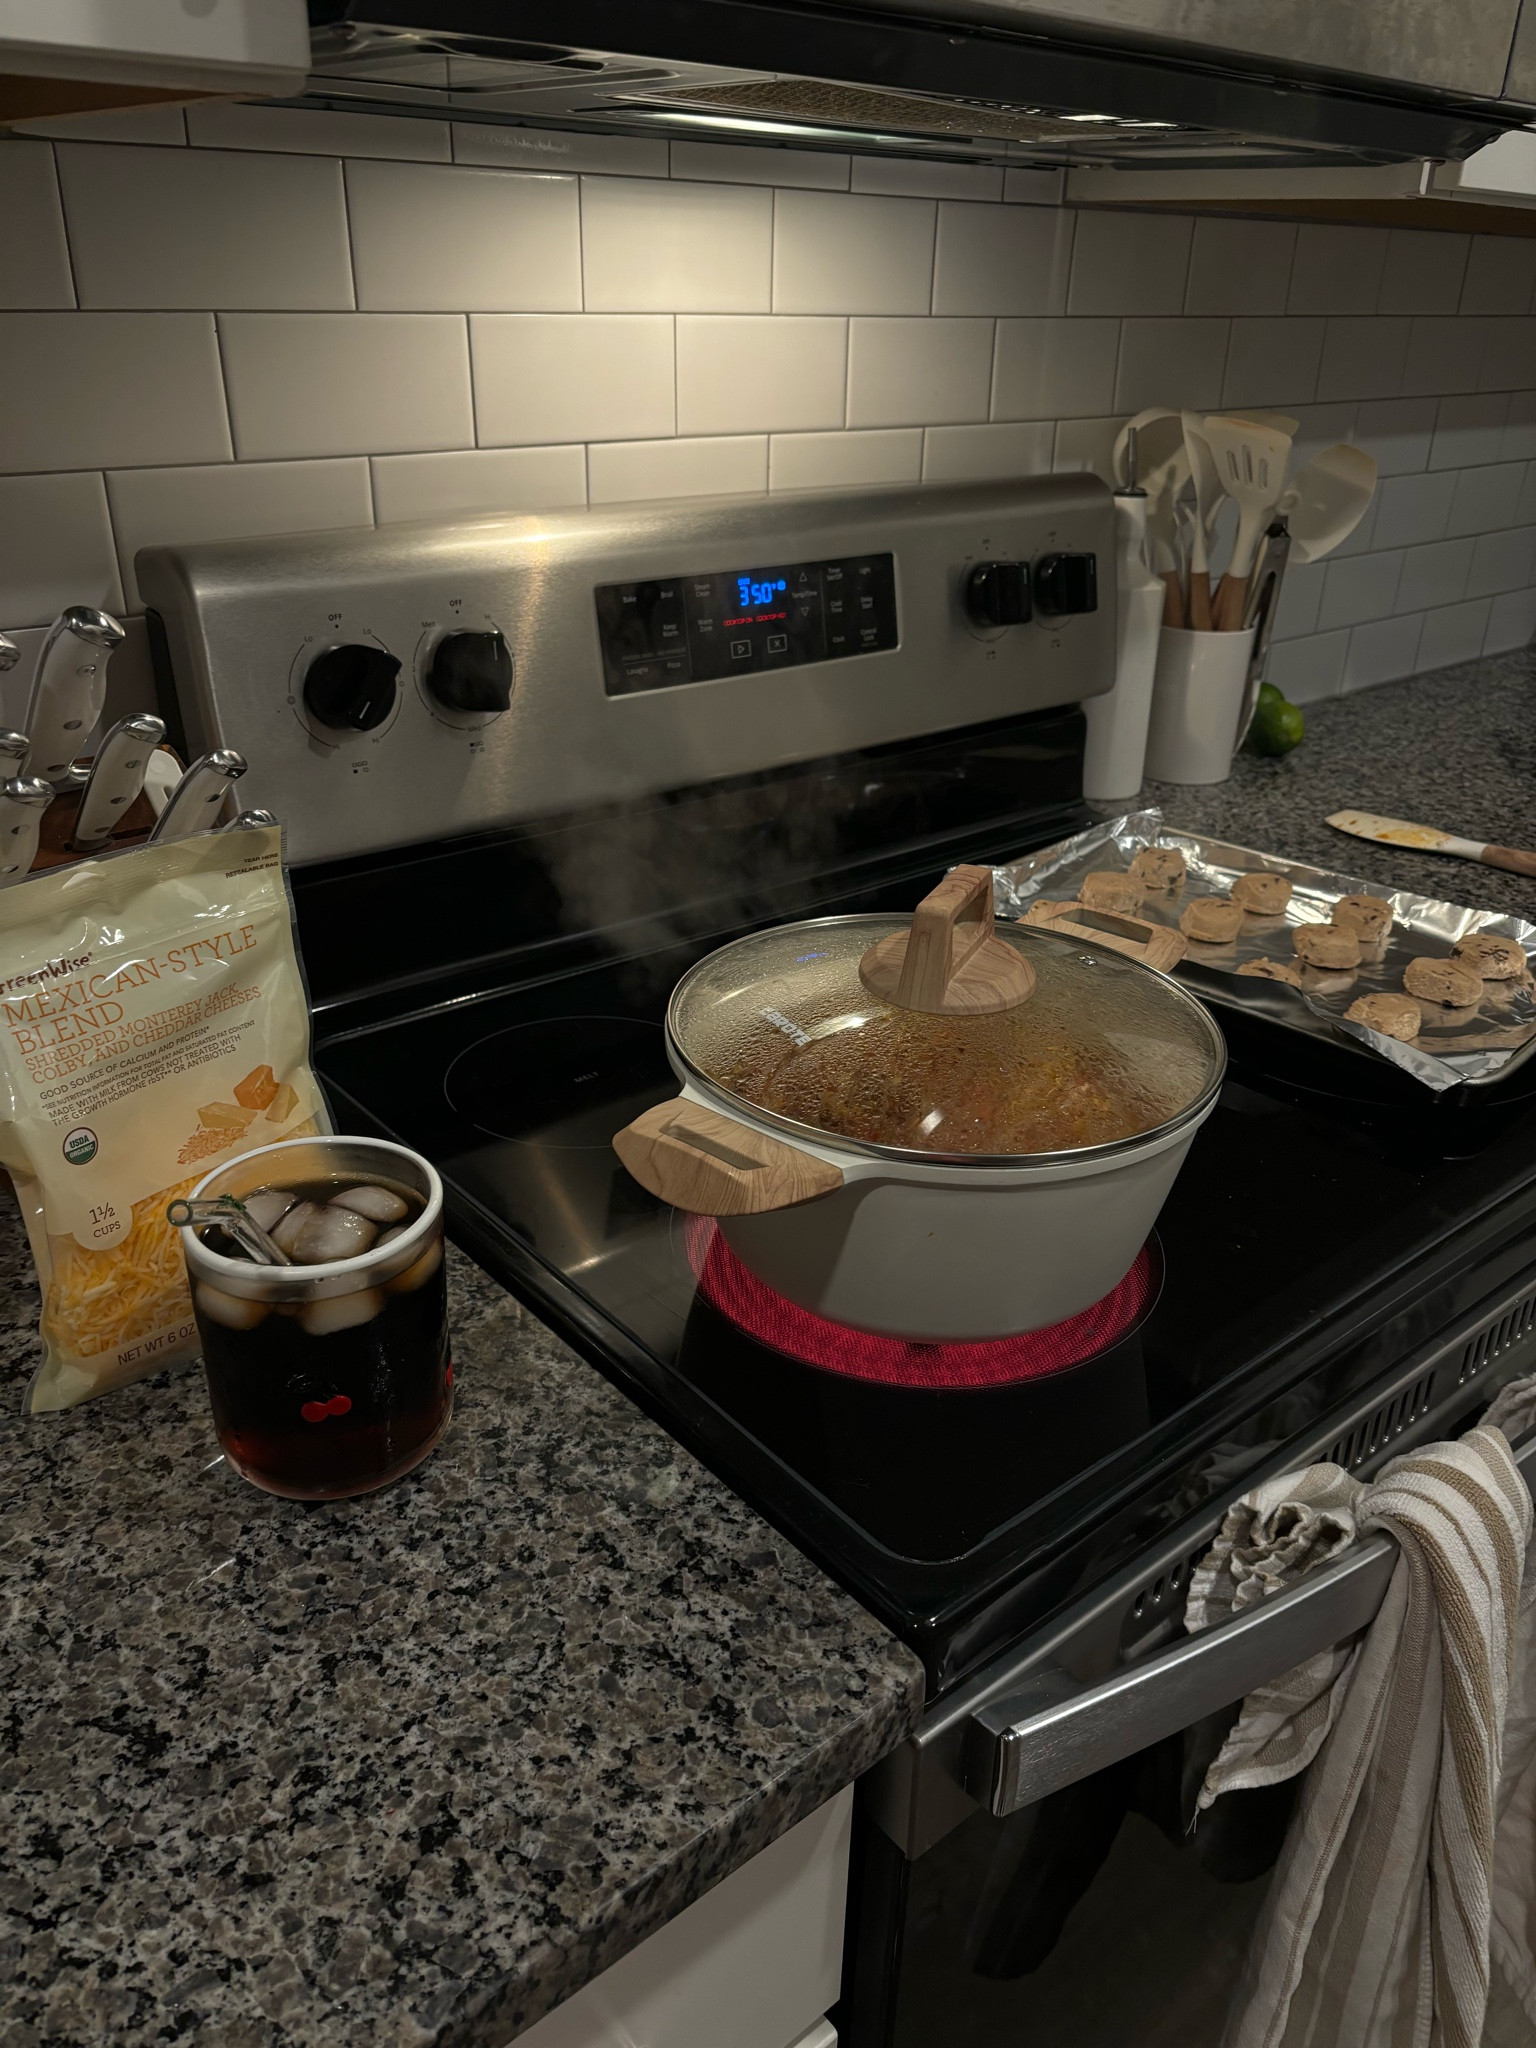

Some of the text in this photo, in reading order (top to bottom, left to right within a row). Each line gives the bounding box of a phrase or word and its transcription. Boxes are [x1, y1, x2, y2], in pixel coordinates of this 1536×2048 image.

[328, 613, 342, 621] OFF
[1, 924, 257, 1028] MEXICAN-STYLE
[11, 1001, 124, 1055] BLEND
[25, 982, 239, 1072] SHREDDED MONTEREY JACK
[32, 985, 261, 1084] COLBY, AND CHEDDAR CHEESES
[40, 1084, 69, 1100] GOOD
[70, 1068, 105, 1089] SOURCE
[105, 1063, 118, 1074] OF
[120, 1049, 157, 1069] CALCIUM
[158, 1041, 175, 1053] AND
[48, 1033, 242, 1119] MADE WITH MILK FROM COWS NOT TREATED WITH
[51, 1114, 71, 1127] THE
[71, 1099, 108, 1120] GROWTH
[108, 1079, 147, 1103] HORMONE
[173, 1064, 187, 1074] OR
[188, 1043, 237, 1069] ANTIBIOTICS
[57, 1087, 92, 1106] NUTRITION
[92, 1070, 130, 1092] INFORMATION
[130, 1065, 143, 1075] FOR
[143, 1057, 162, 1071] TOTAL
[161, 1052, 172, 1062] FAT
[172, 1046, 185, 1057] AND
[216, 1029, 229, 1039] FAT
[228, 1019, 256, 1035] CONTENT
[69, 1134, 90, 1149] USDA
[69, 1144, 95, 1159] ORGANIC
[93, 1220, 121, 1238] CUPS
[117, 1322, 196, 1366] NET WT 6 OZ
